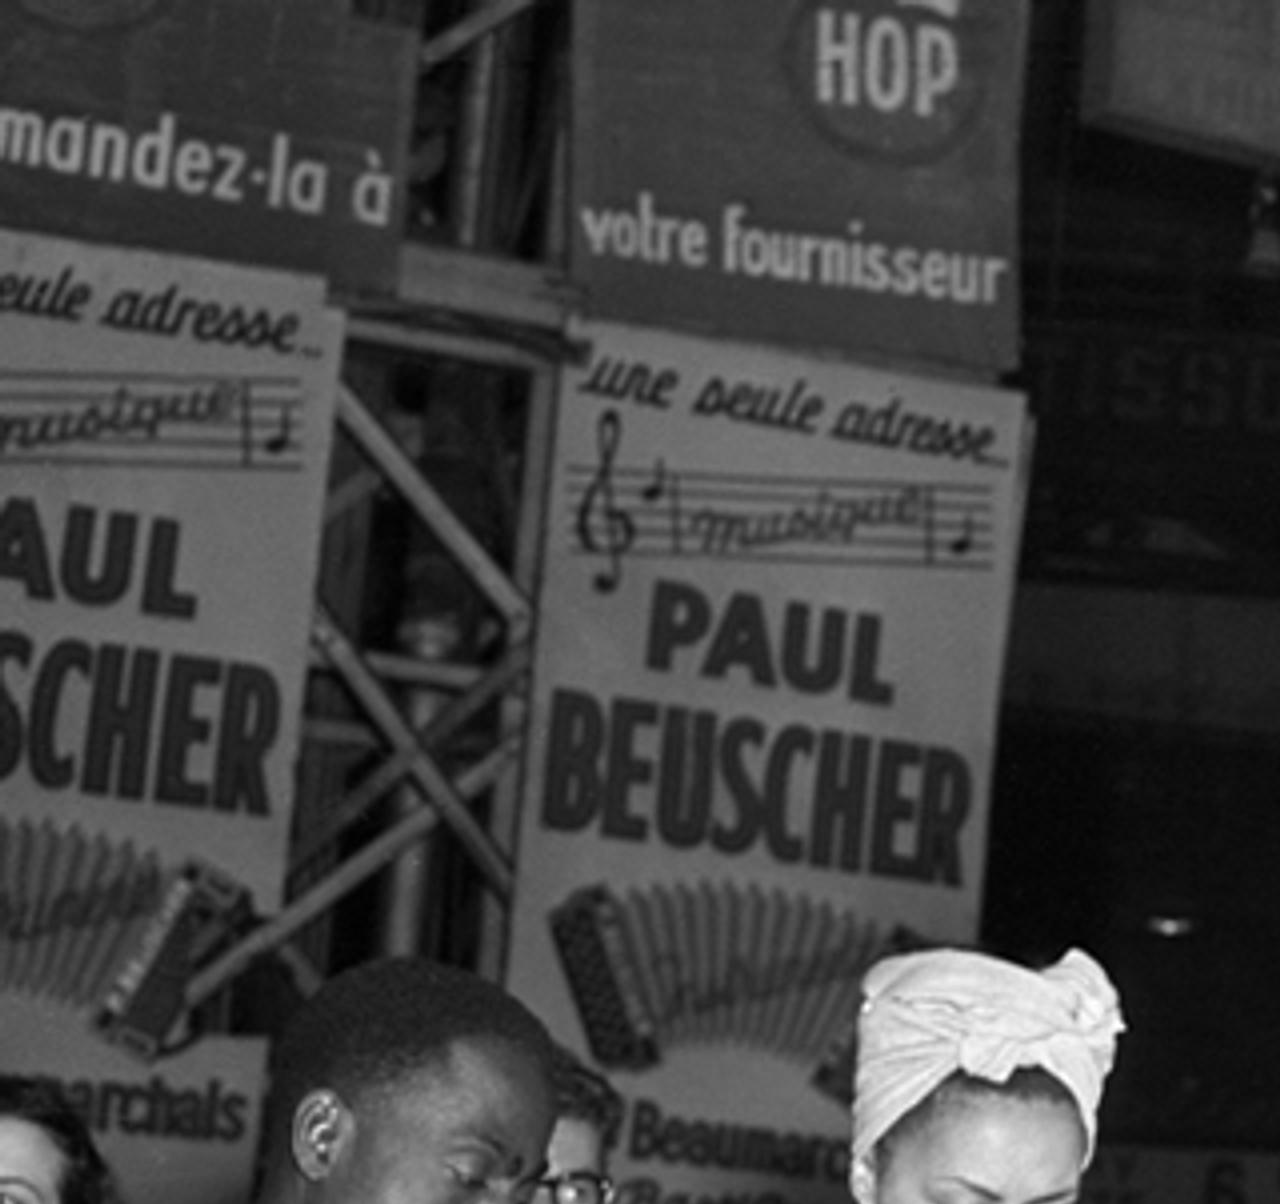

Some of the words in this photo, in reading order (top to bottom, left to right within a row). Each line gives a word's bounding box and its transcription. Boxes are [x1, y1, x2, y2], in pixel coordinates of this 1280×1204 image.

[815, 9, 959, 117] HOP
[353, 148, 392, 227] à
[582, 190, 707, 267] votre
[722, 204, 1007, 304] fournisseur
[577, 355, 679, 409] une
[0, 495, 197, 622] AUL
[646, 578, 894, 708] PAUL
[538, 687, 974, 889] BEUSCHER
